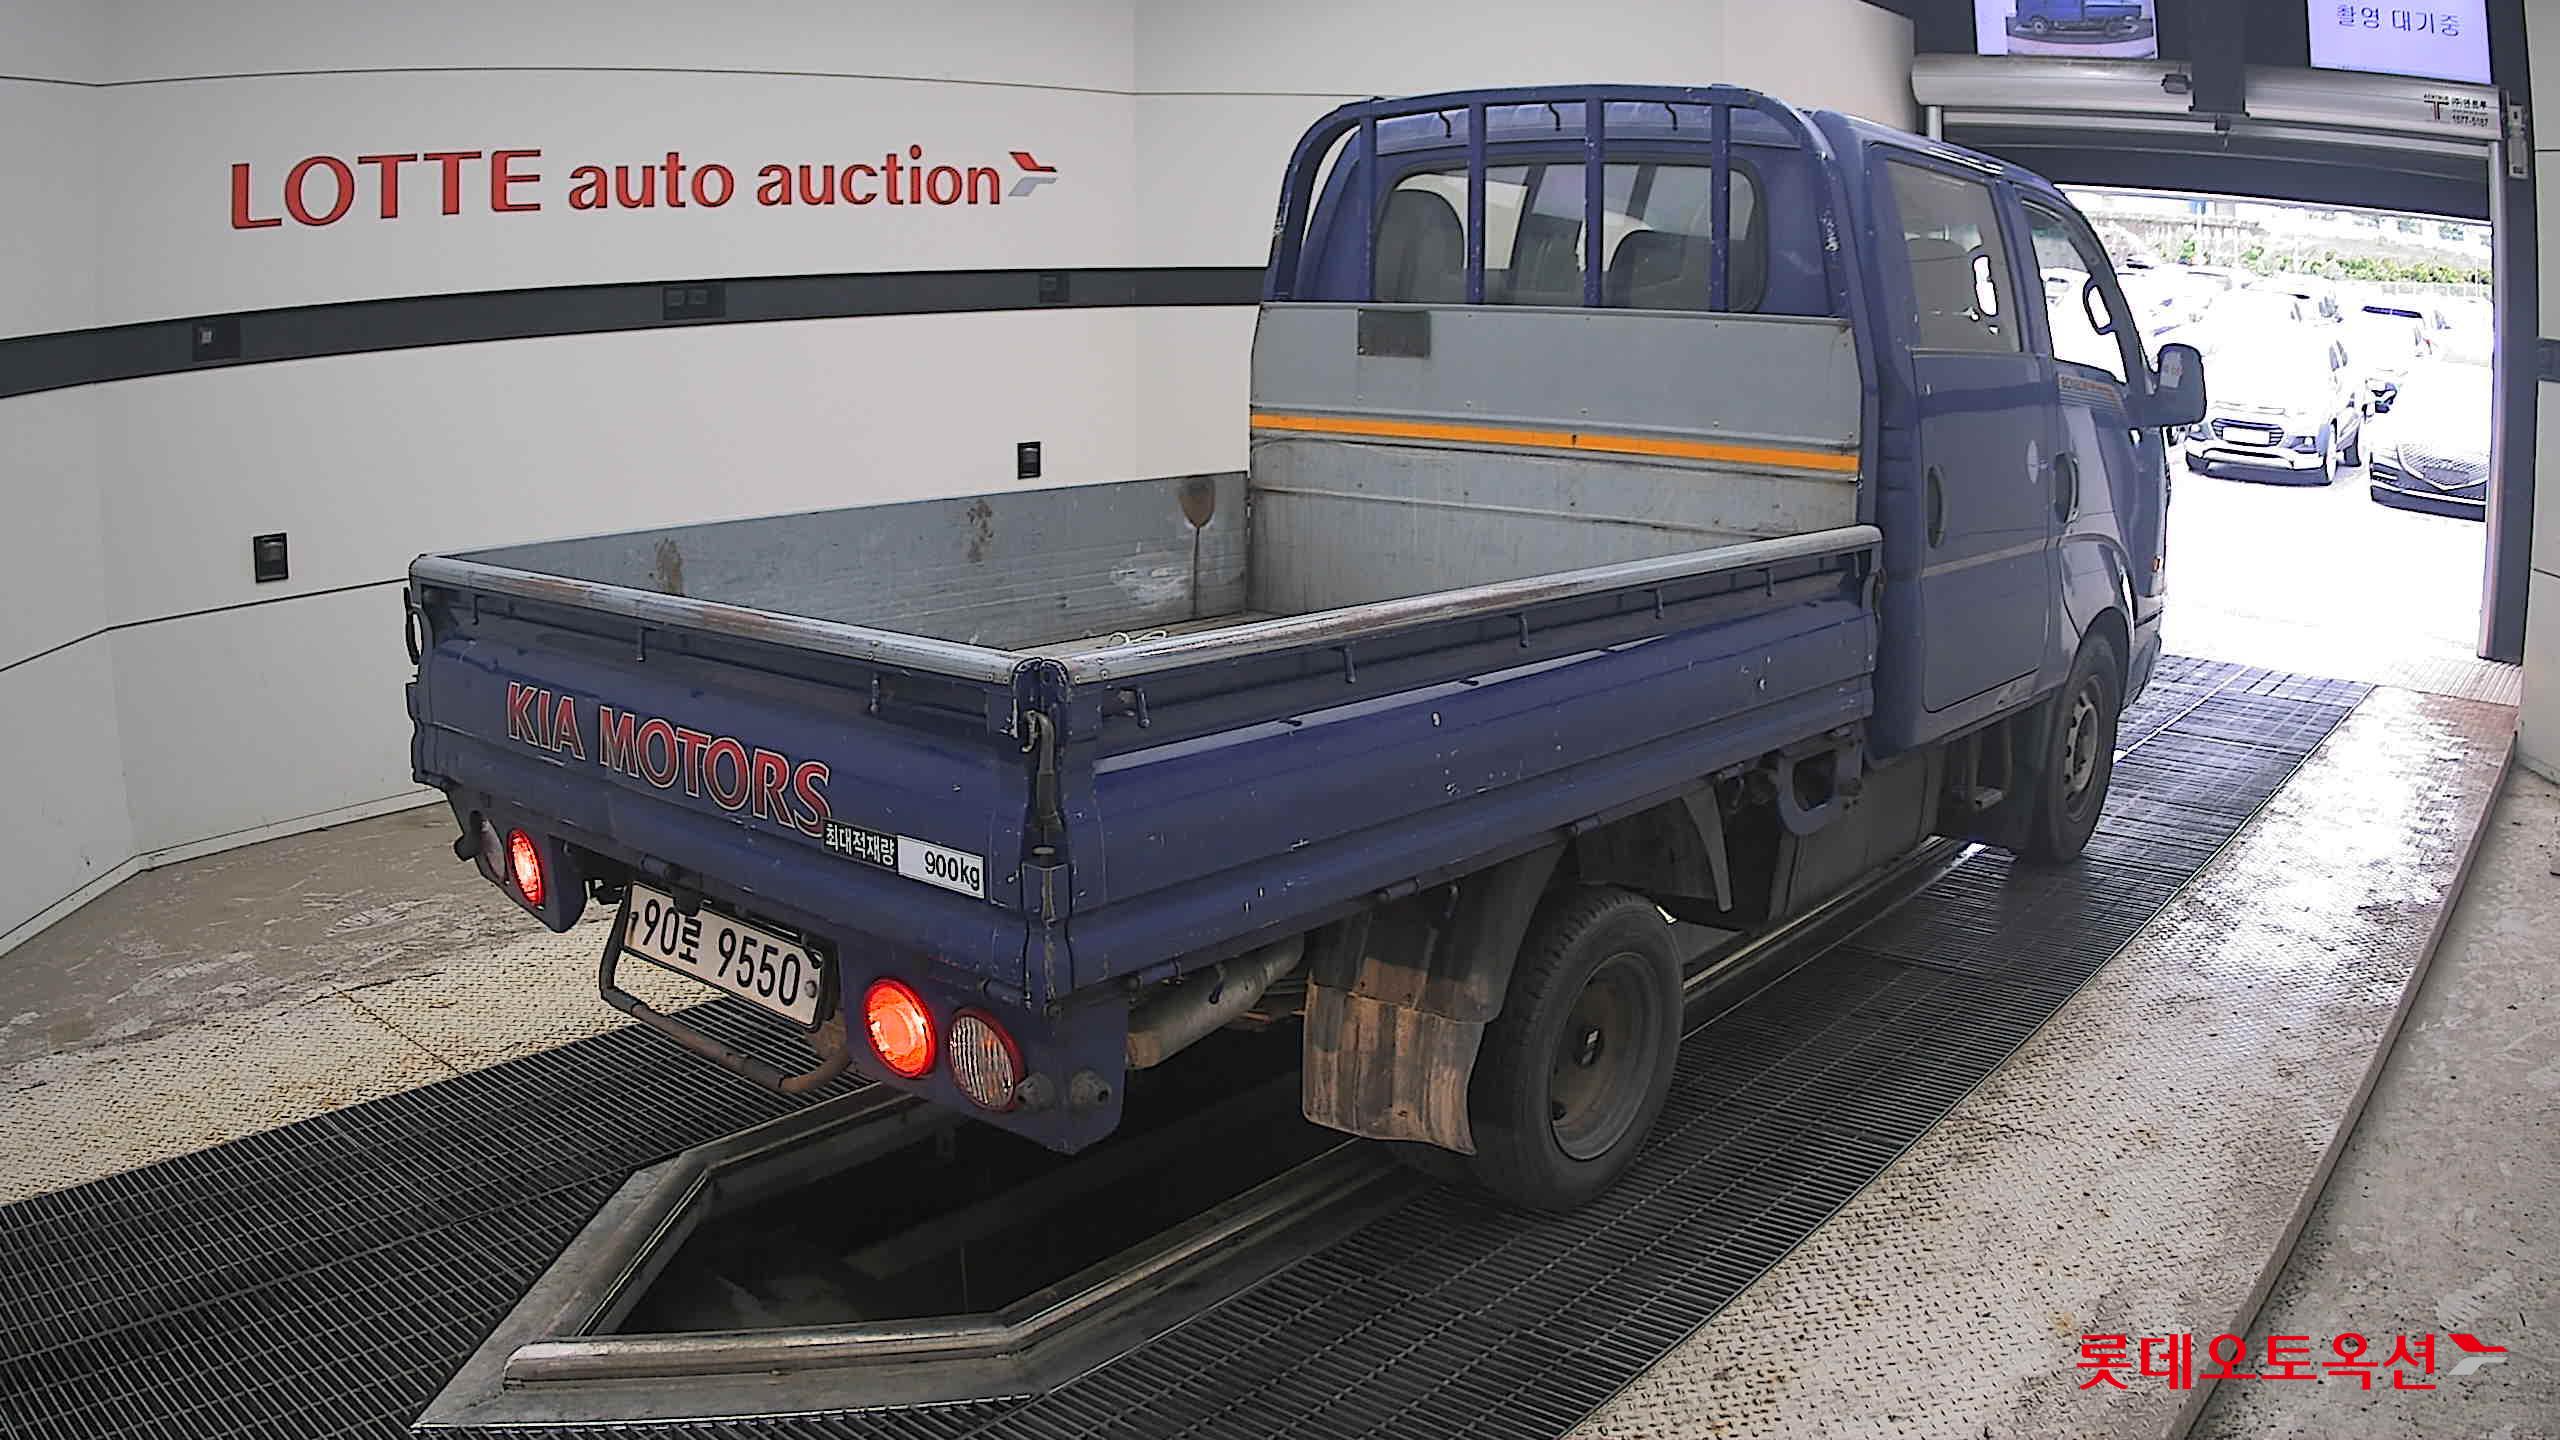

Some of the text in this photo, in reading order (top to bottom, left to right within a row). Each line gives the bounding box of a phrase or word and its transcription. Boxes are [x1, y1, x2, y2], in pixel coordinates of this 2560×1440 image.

[2337, 5, 2460, 37] 촬영 대기중
[231, 144, 1001, 230] LOTTE auto auction
[505, 680, 834, 838] KIA MOTORS
[825, 822, 981, 892] 최대적재량 900kg
[641, 898, 802, 1007] 90로 9550
